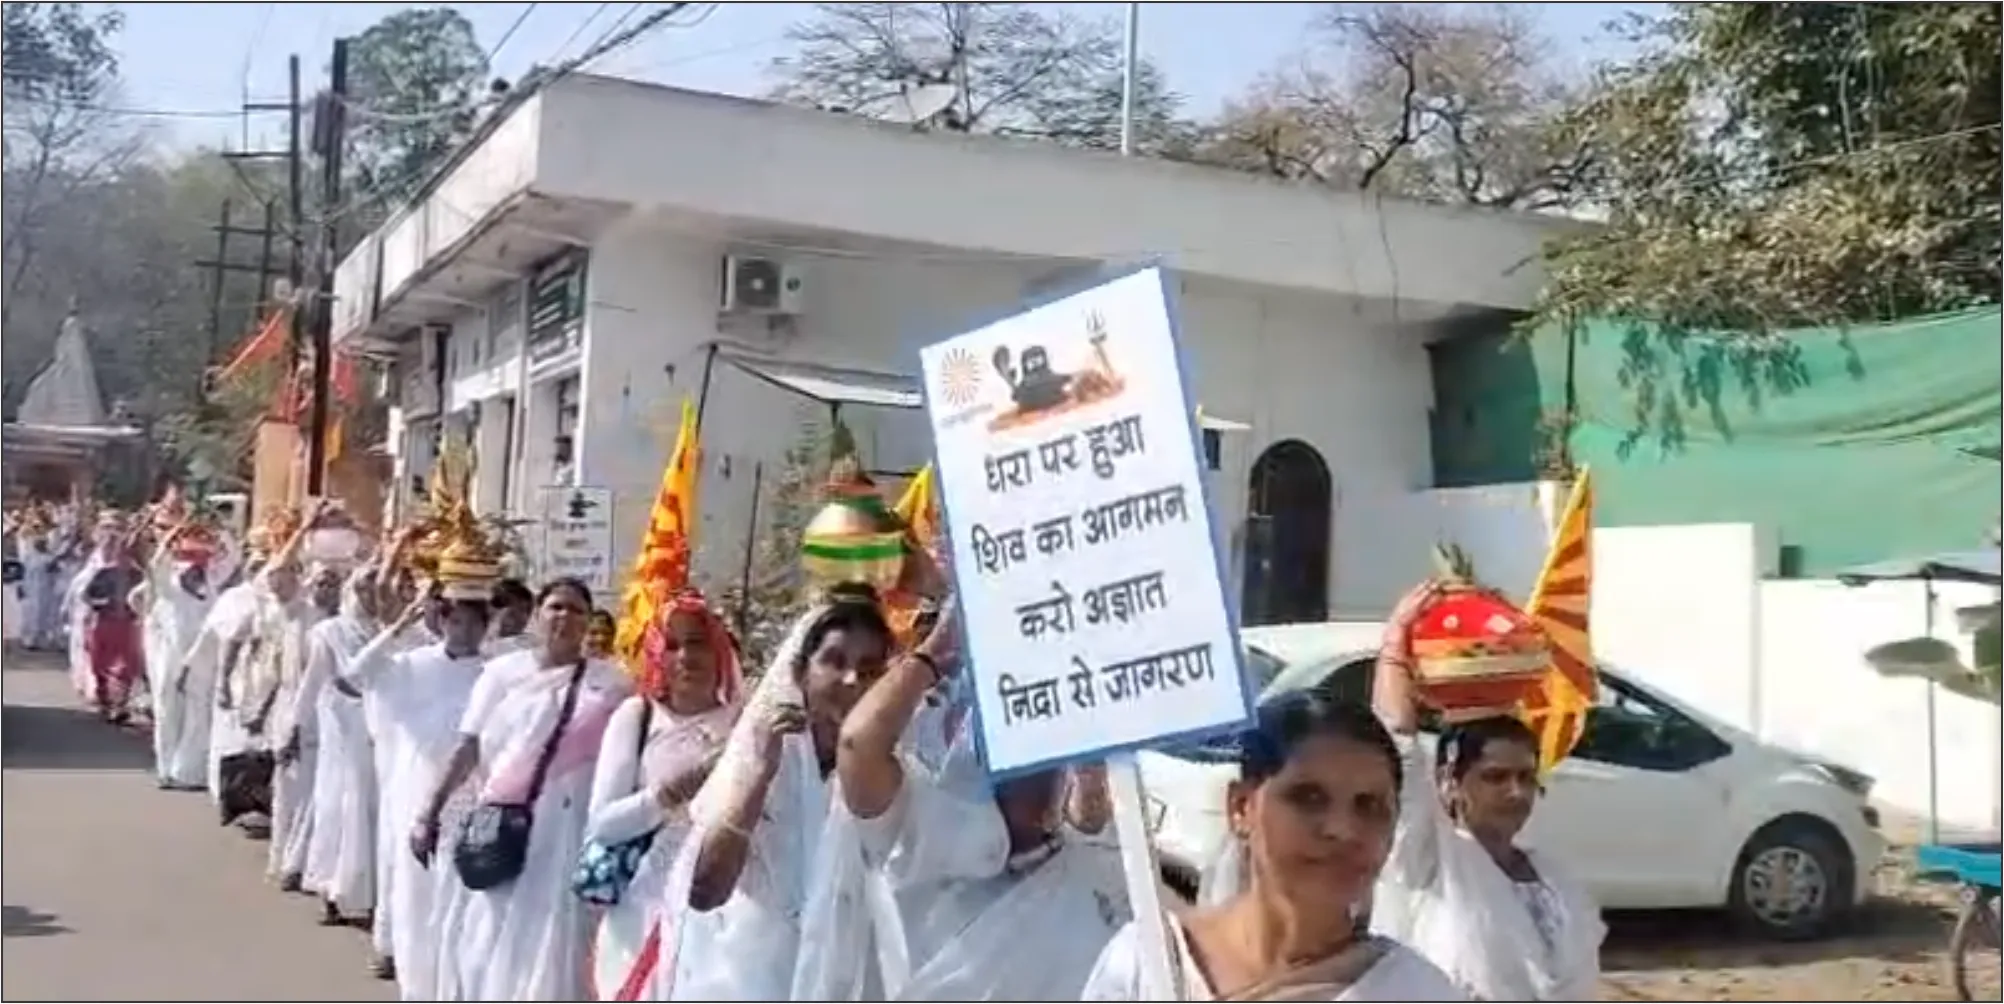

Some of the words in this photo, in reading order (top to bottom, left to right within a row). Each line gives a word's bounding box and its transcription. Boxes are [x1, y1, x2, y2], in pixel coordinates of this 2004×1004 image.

[984, 449, 1031, 493] धरा
[1039, 434, 1081, 476] पर
[1084, 414, 1145, 478] हुआ
[971, 524, 1027, 574] शिव
[1033, 515, 1074, 557] का
[1082, 484, 1189, 546] आगमन
[1014, 580, 1075, 640] करो
[1083, 570, 1168, 626] अज्ञात
[1067, 654, 1095, 708] से
[1102, 642, 1215, 703] जागरण
